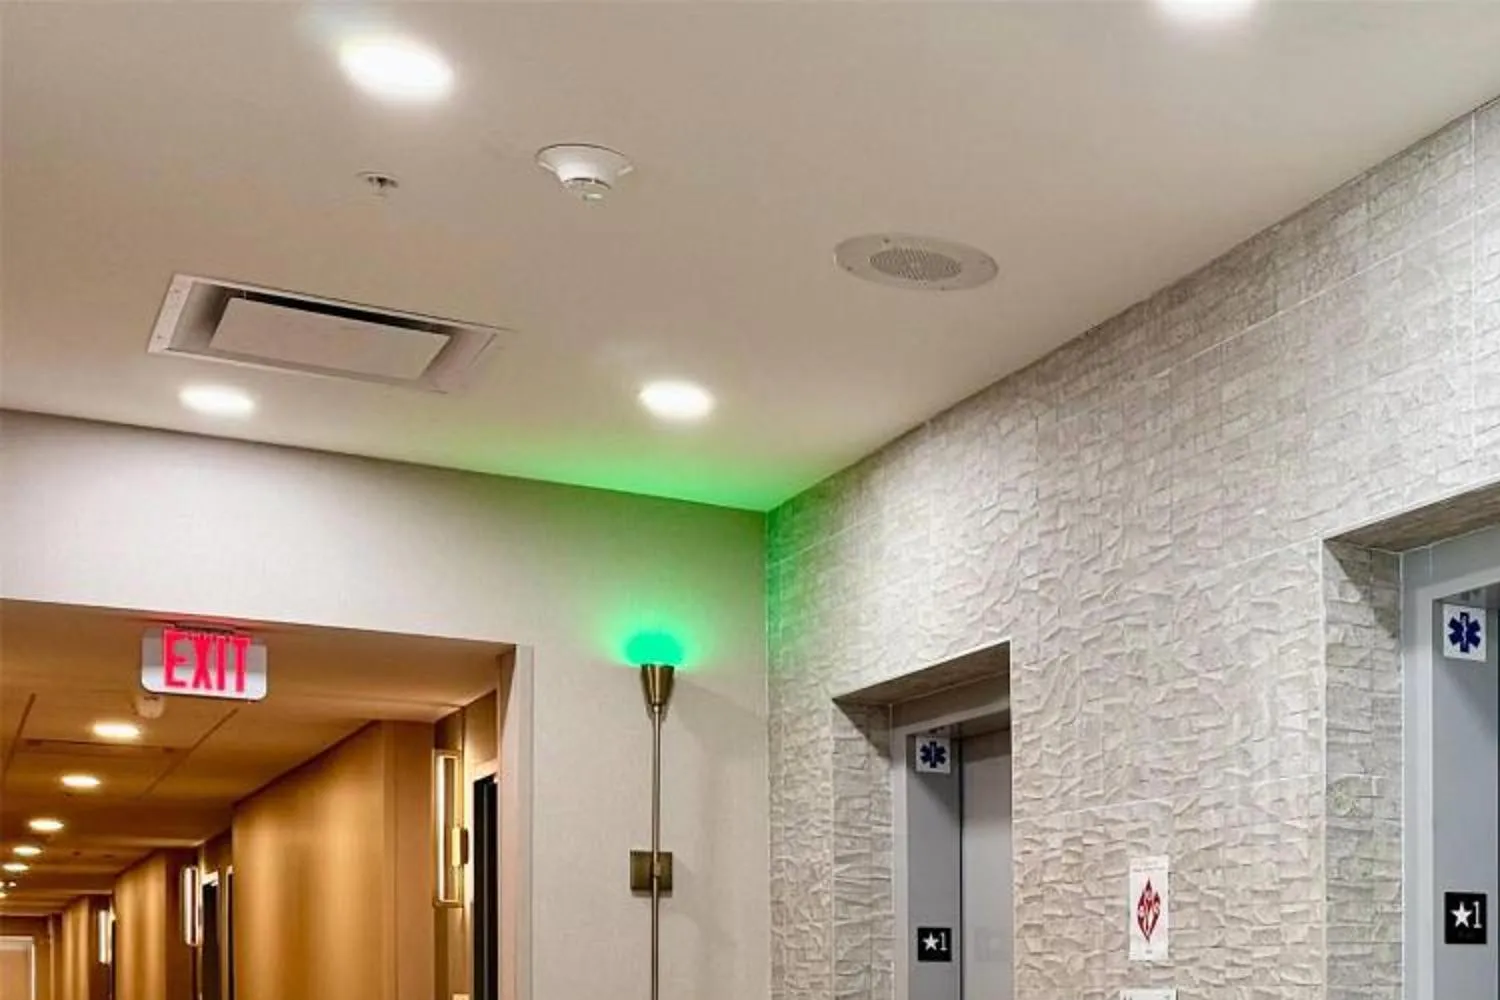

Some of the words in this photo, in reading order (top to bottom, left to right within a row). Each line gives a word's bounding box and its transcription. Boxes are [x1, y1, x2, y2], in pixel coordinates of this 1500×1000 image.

[163, 628, 251, 693] EXIT
[1472, 901, 1483, 929] 1
[939, 932, 948, 951] 1
